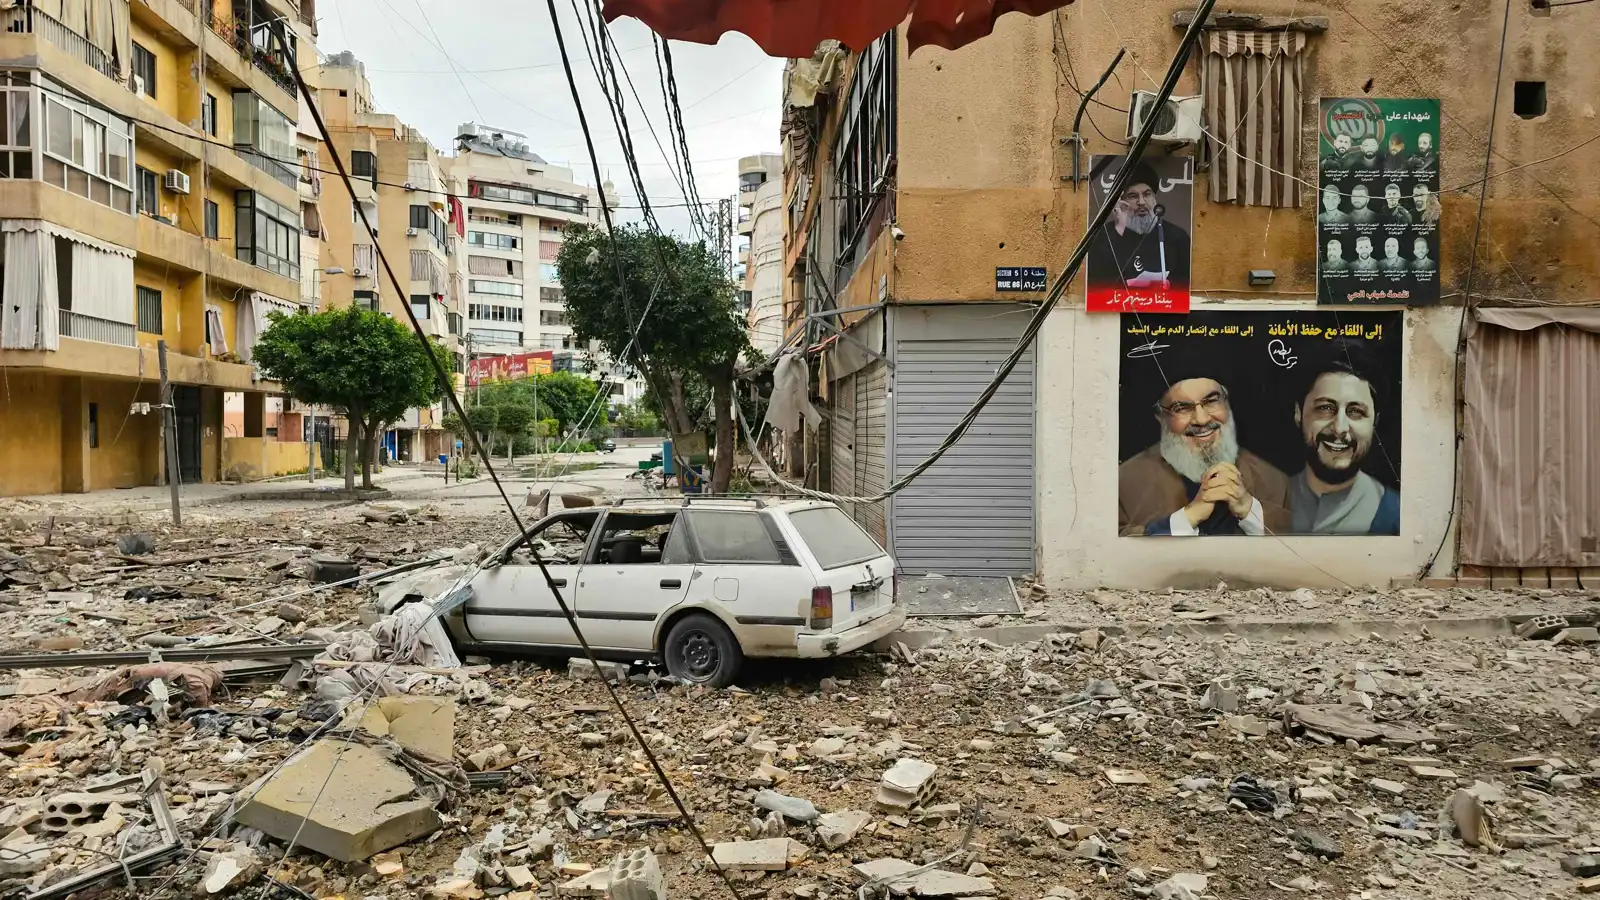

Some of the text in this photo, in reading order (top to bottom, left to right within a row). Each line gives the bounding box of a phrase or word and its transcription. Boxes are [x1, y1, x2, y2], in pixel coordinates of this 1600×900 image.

[1386, 111, 1402, 122] على
[1402, 111, 1431, 123] شهداء
[1014, 269, 1019, 277] 5
[1347, 289, 1410, 302] تقدمة شباب الحي
[1127, 325, 1150, 335] السيف
[1151, 325, 1167, 336] على
[1167, 325, 1184, 336] الدم
[1208, 327, 1219, 337] مع
[1220, 325, 1239, 334] اللقاء
[1240, 325, 1254, 337] إلى
[1268, 320, 1382, 340] إلى اللقاء مع حفظ الأمانة
